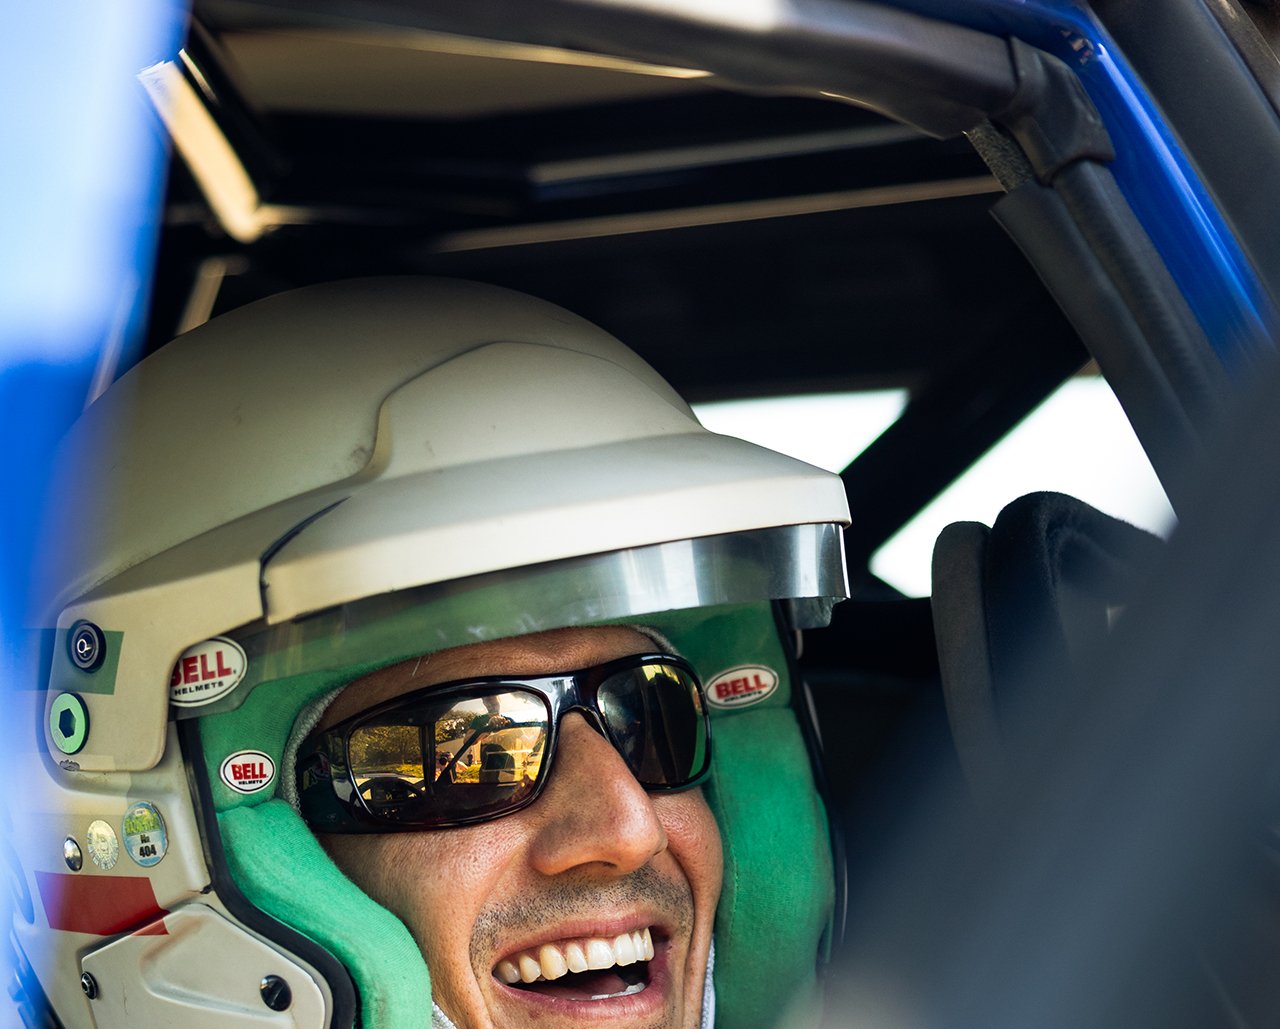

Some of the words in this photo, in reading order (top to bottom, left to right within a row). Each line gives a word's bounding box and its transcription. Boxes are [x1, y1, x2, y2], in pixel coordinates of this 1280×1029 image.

[174, 681, 224, 695] HELMETS
[716, 675, 767, 699] BELL
[231, 763, 267, 780] BELL
[139, 845, 157, 857] 404
